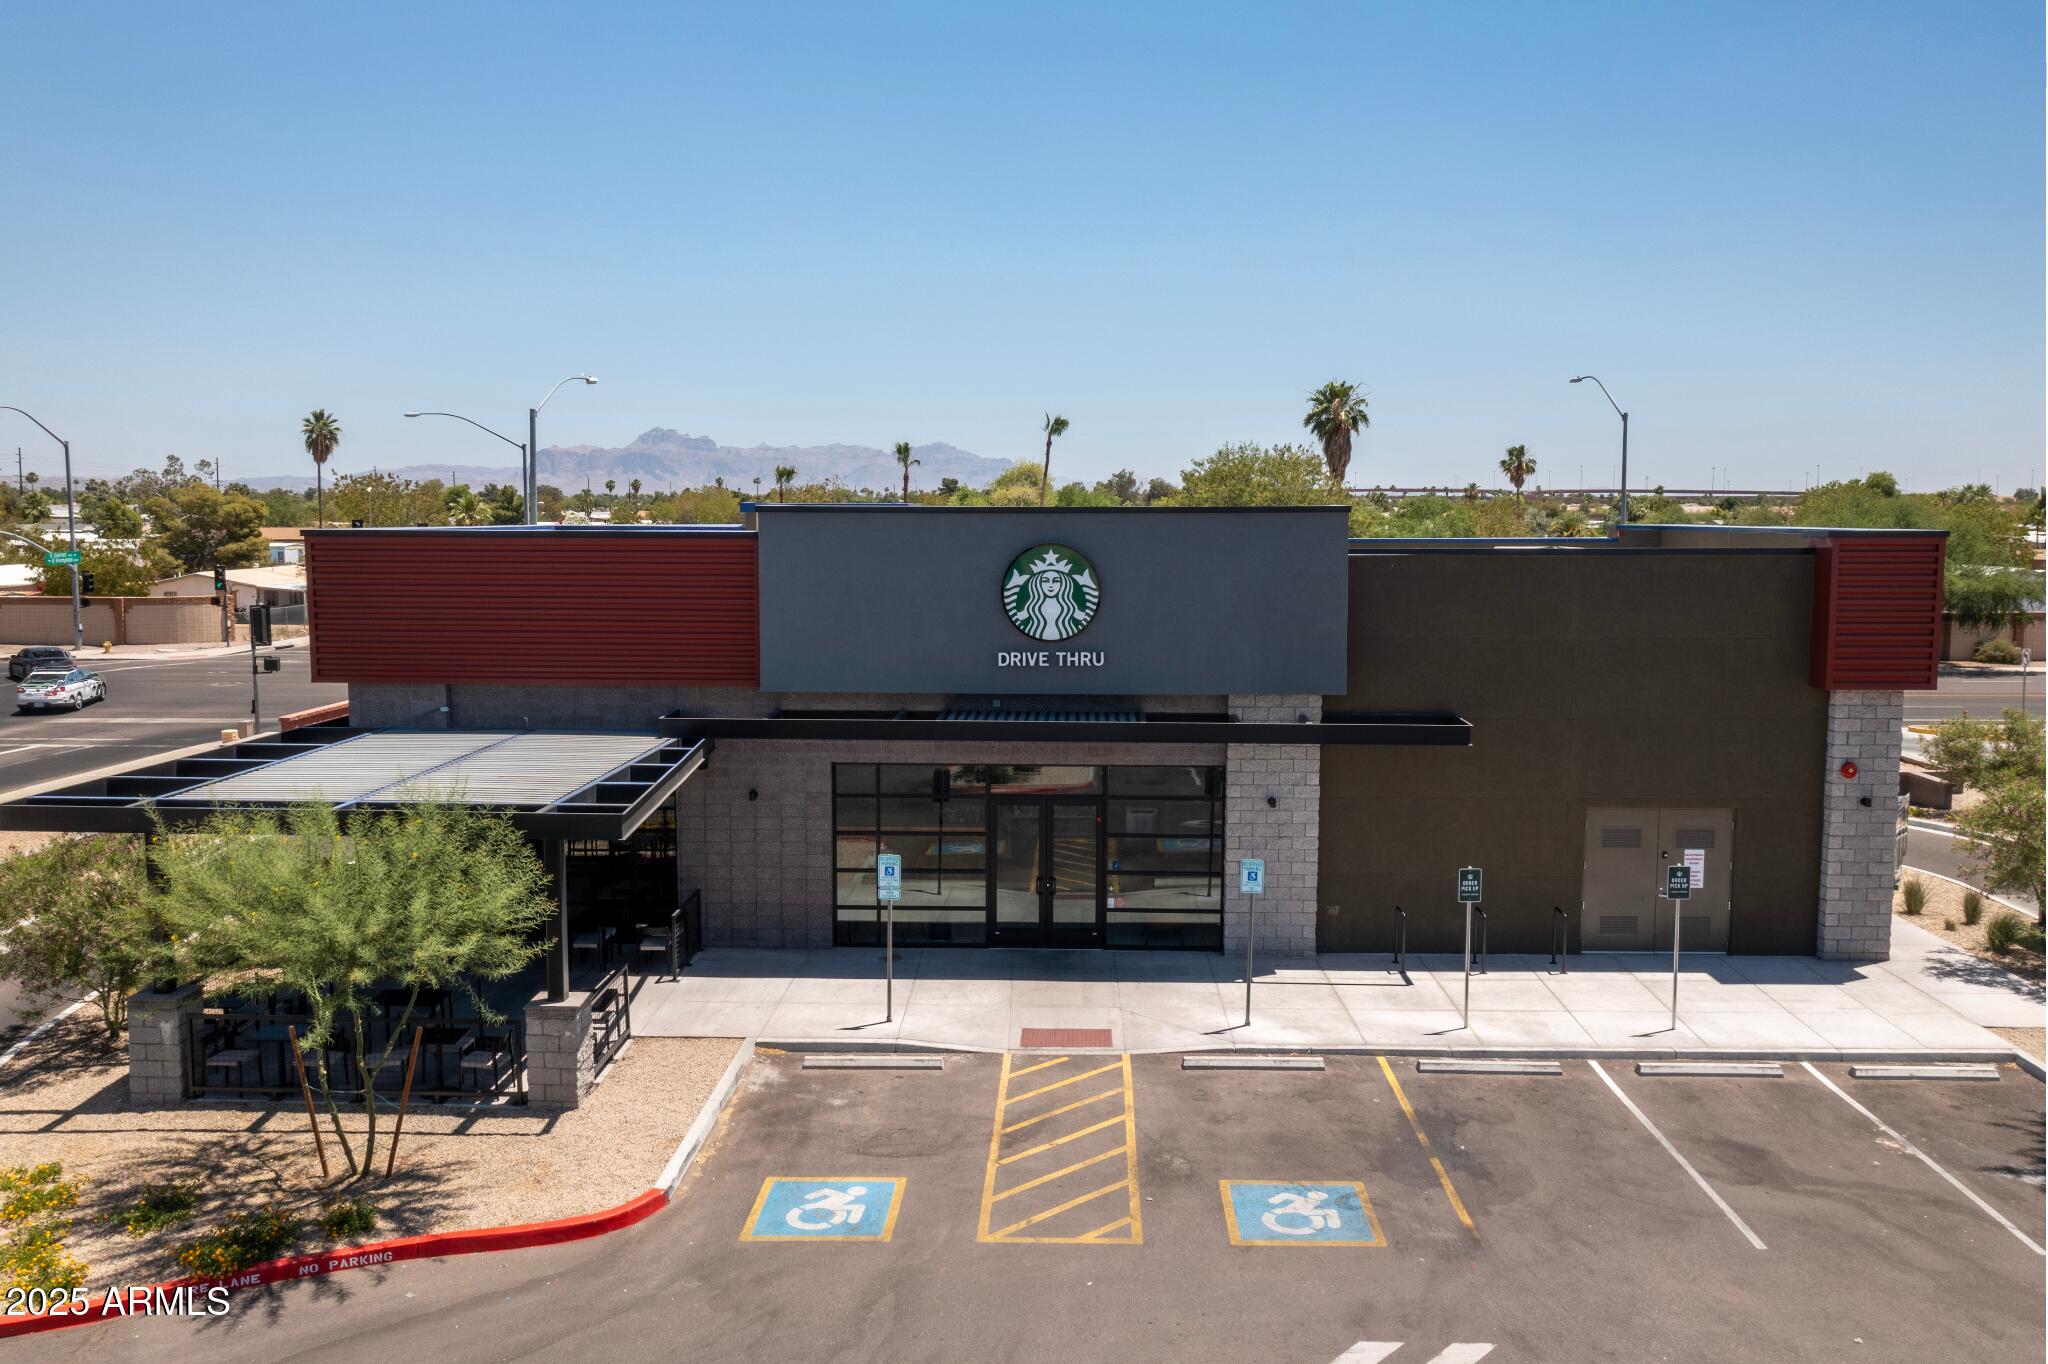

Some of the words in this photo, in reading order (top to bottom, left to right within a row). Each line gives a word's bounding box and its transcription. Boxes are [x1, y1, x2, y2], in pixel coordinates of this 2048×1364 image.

[998, 652, 1050, 667] DRIVE
[1055, 651, 1105, 666] THRU
[219, 1273, 261, 1289] LANE
[299, 1263, 319, 1275] NO
[329, 1251, 393, 1271] PARKING
